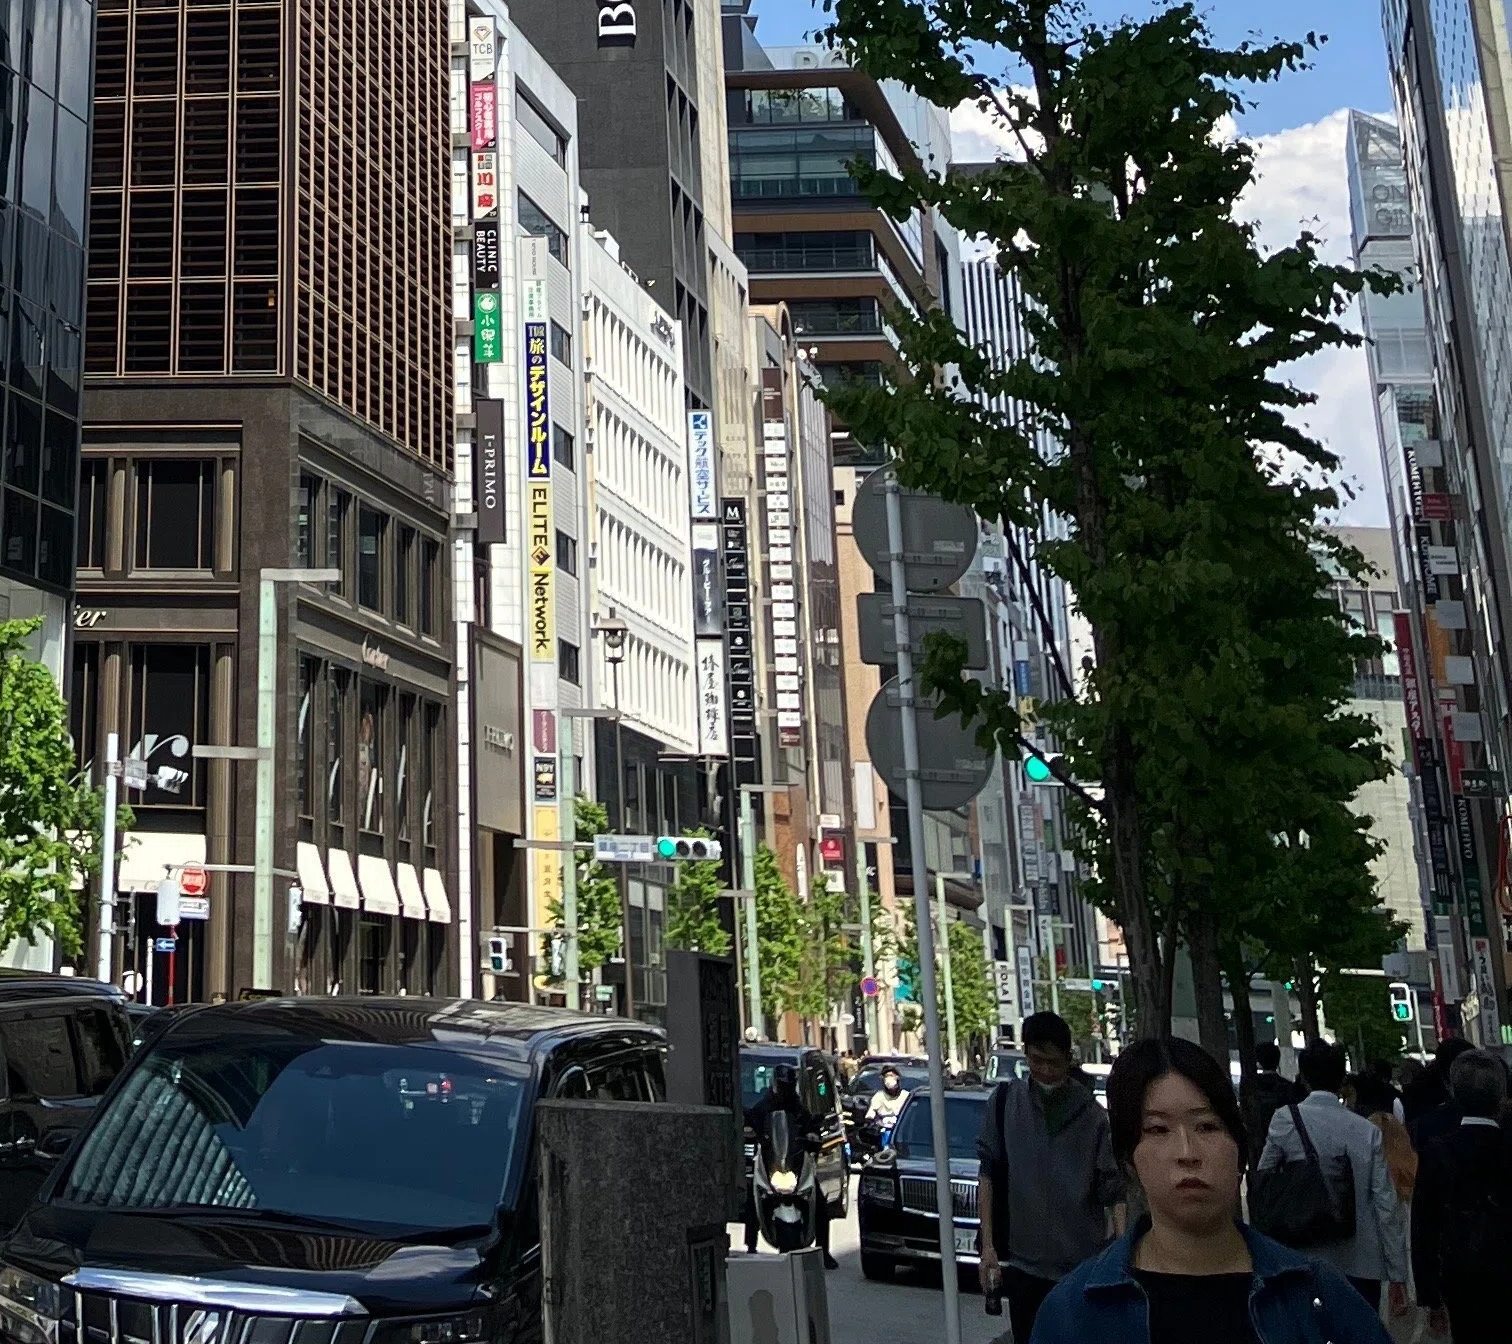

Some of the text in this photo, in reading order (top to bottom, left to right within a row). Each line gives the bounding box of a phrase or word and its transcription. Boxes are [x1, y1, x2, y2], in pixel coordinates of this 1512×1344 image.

[473, 43, 493, 55] TCB
[476, 229, 486, 274] BEAUTY
[487, 229, 498, 273] CLINIC
[529, 338, 548, 474] 旅のデザインルーム
[484, 434, 497, 510] I-PRIMO
[694, 431, 710, 514] テック航空サービス
[532, 487, 549, 547] ELITE
[1457, 798, 1473, 859] KOMEHYO
